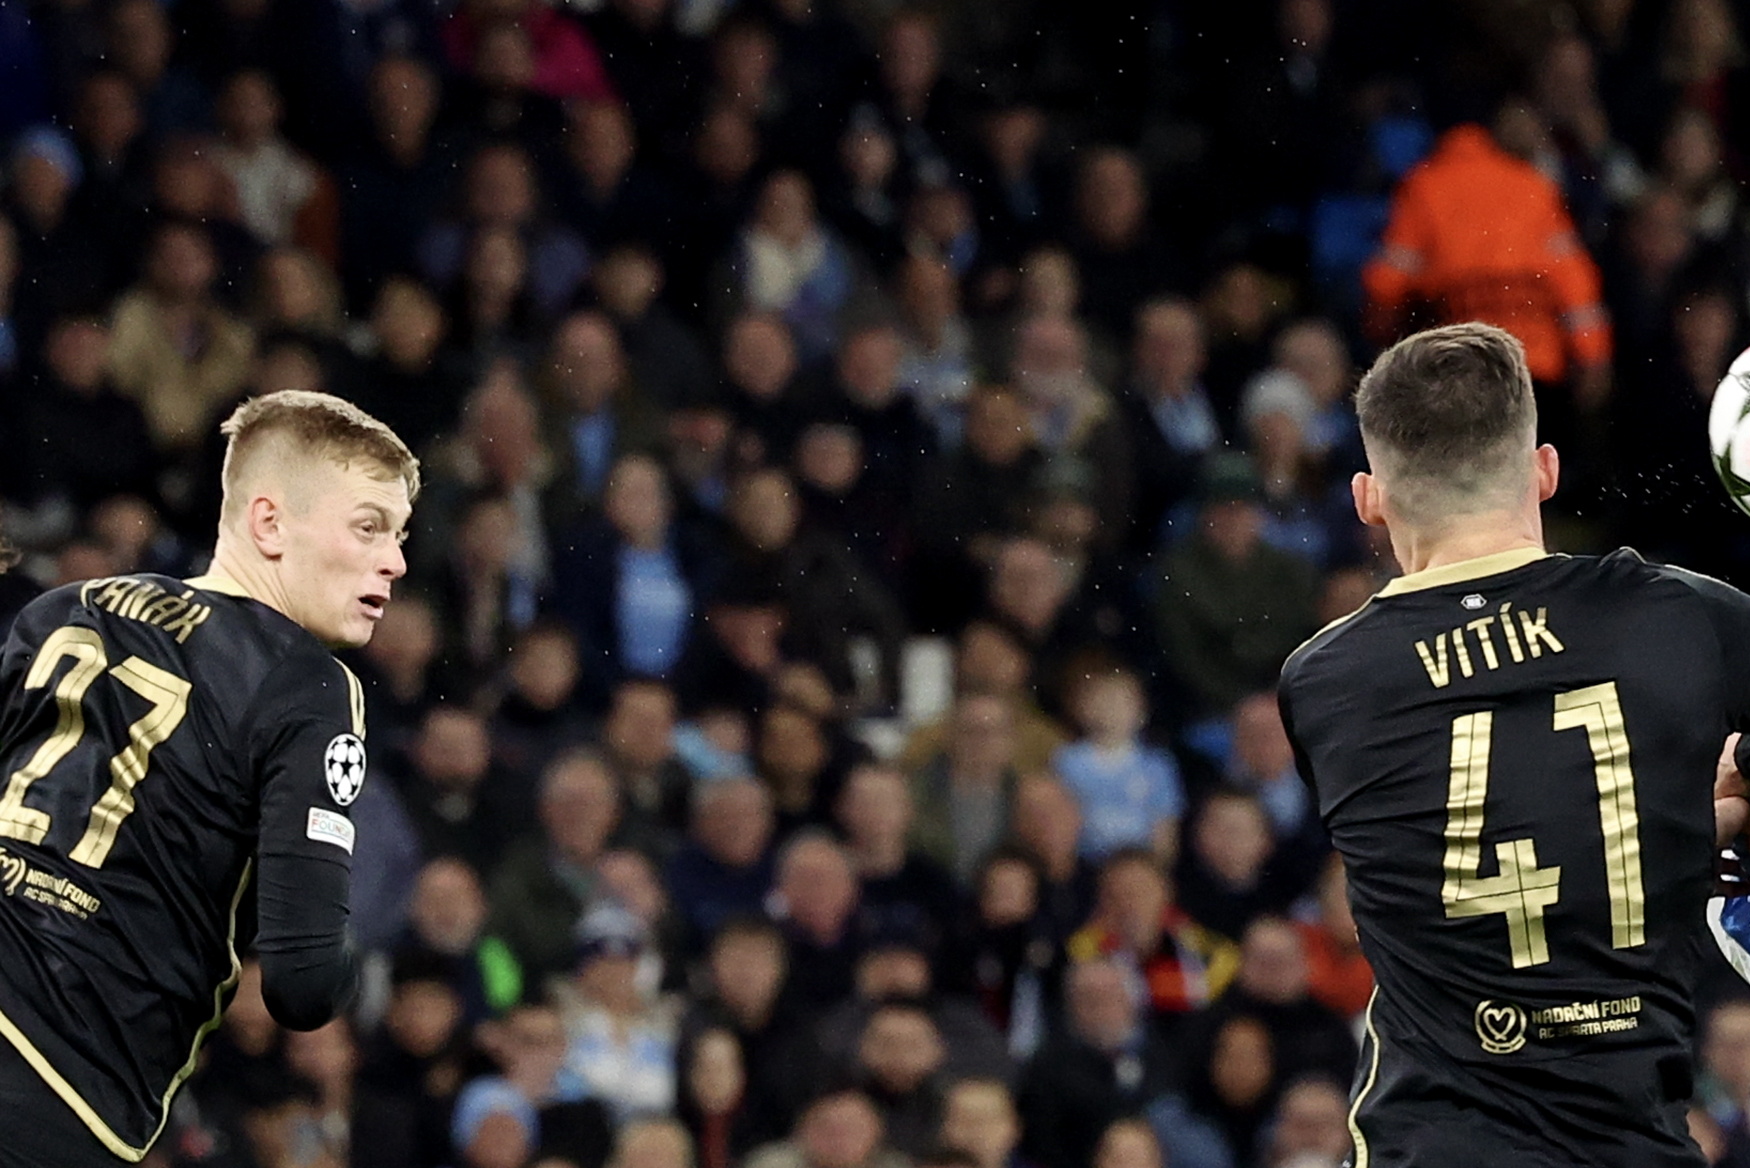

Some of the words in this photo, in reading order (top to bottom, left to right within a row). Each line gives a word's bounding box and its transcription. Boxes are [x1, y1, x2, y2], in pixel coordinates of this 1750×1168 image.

[1414, 602, 1566, 688] VITÍK
[0, 625, 193, 869] 27
[1441, 681, 1647, 970] 41
[62, 882, 101, 913] FOND
[1531, 1000, 1599, 1024] NADAČNÍ
[1601, 996, 1641, 1018] FOND
[1539, 1027, 1555, 1039] AC
[1602, 1017, 1638, 1033] PRAHA
